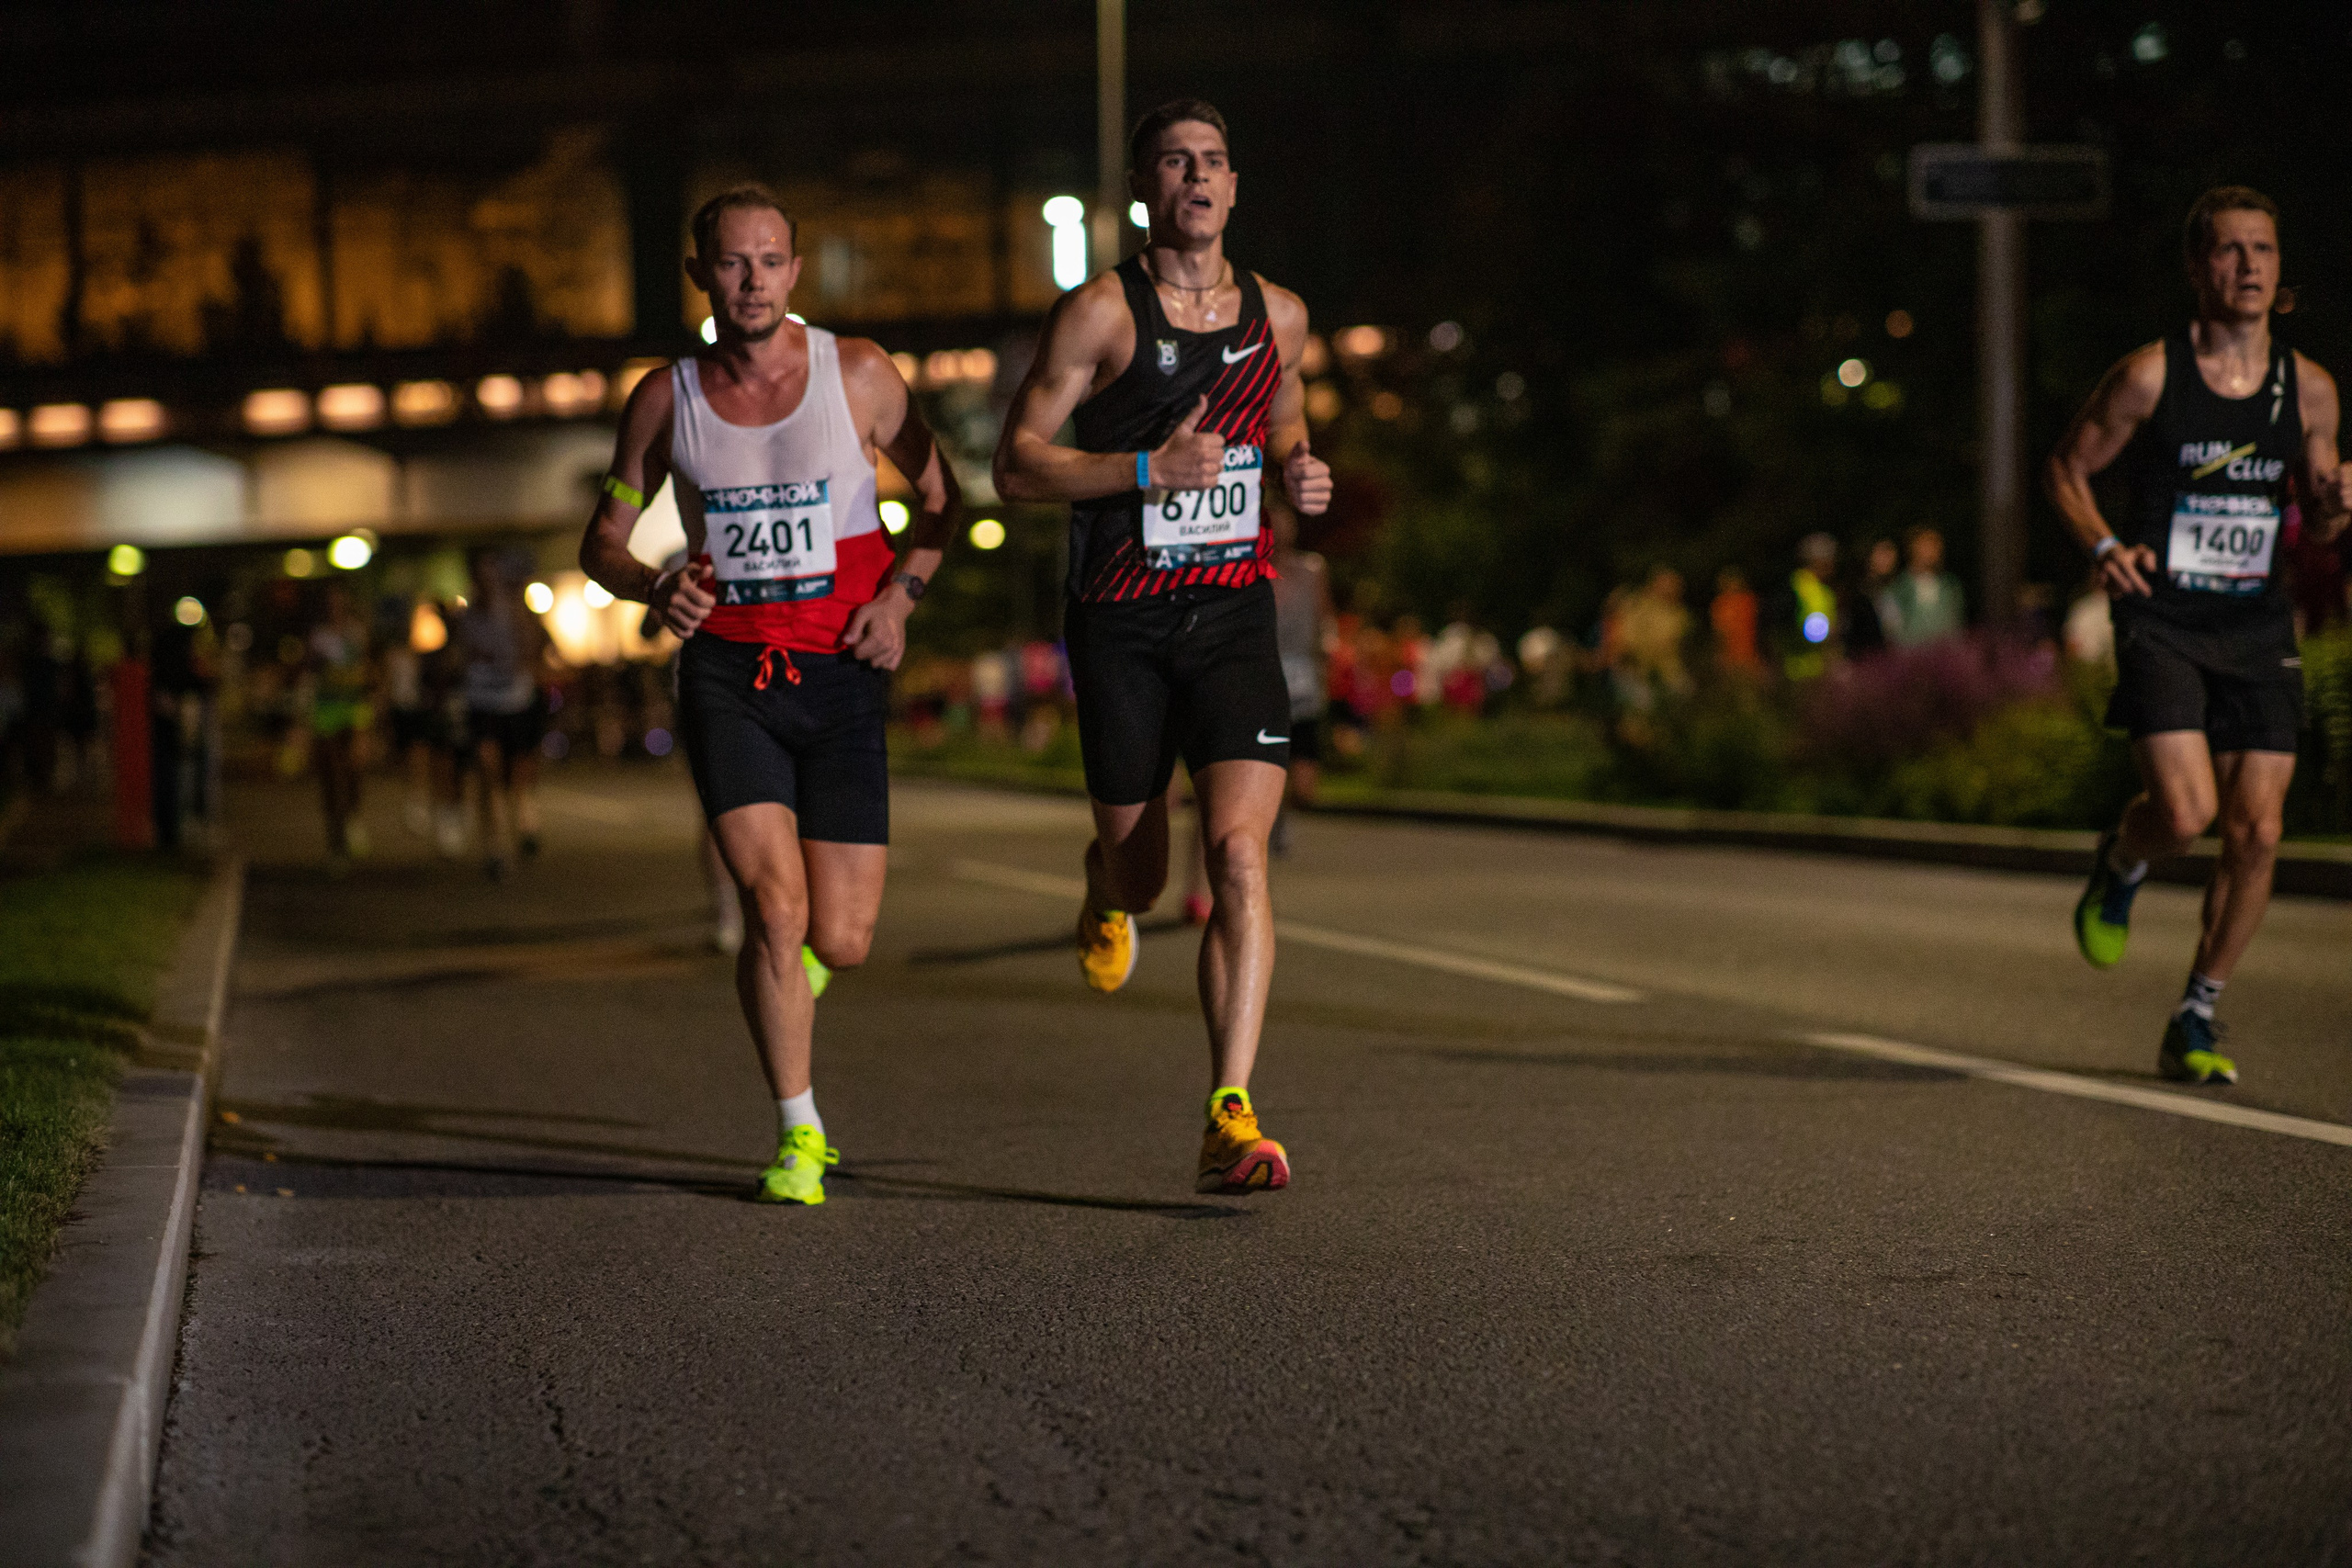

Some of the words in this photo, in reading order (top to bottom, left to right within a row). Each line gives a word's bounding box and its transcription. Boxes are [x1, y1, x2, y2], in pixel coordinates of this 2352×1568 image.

[2179, 440, 2232, 467] RUN
[2226, 457, 2284, 482] CLUB
[1162, 482, 1246, 521] 6700
[725, 517, 812, 558] 2401
[1180, 521, 1231, 536] ВАСИЛИЙ
[2188, 523, 2265, 556] 1400
